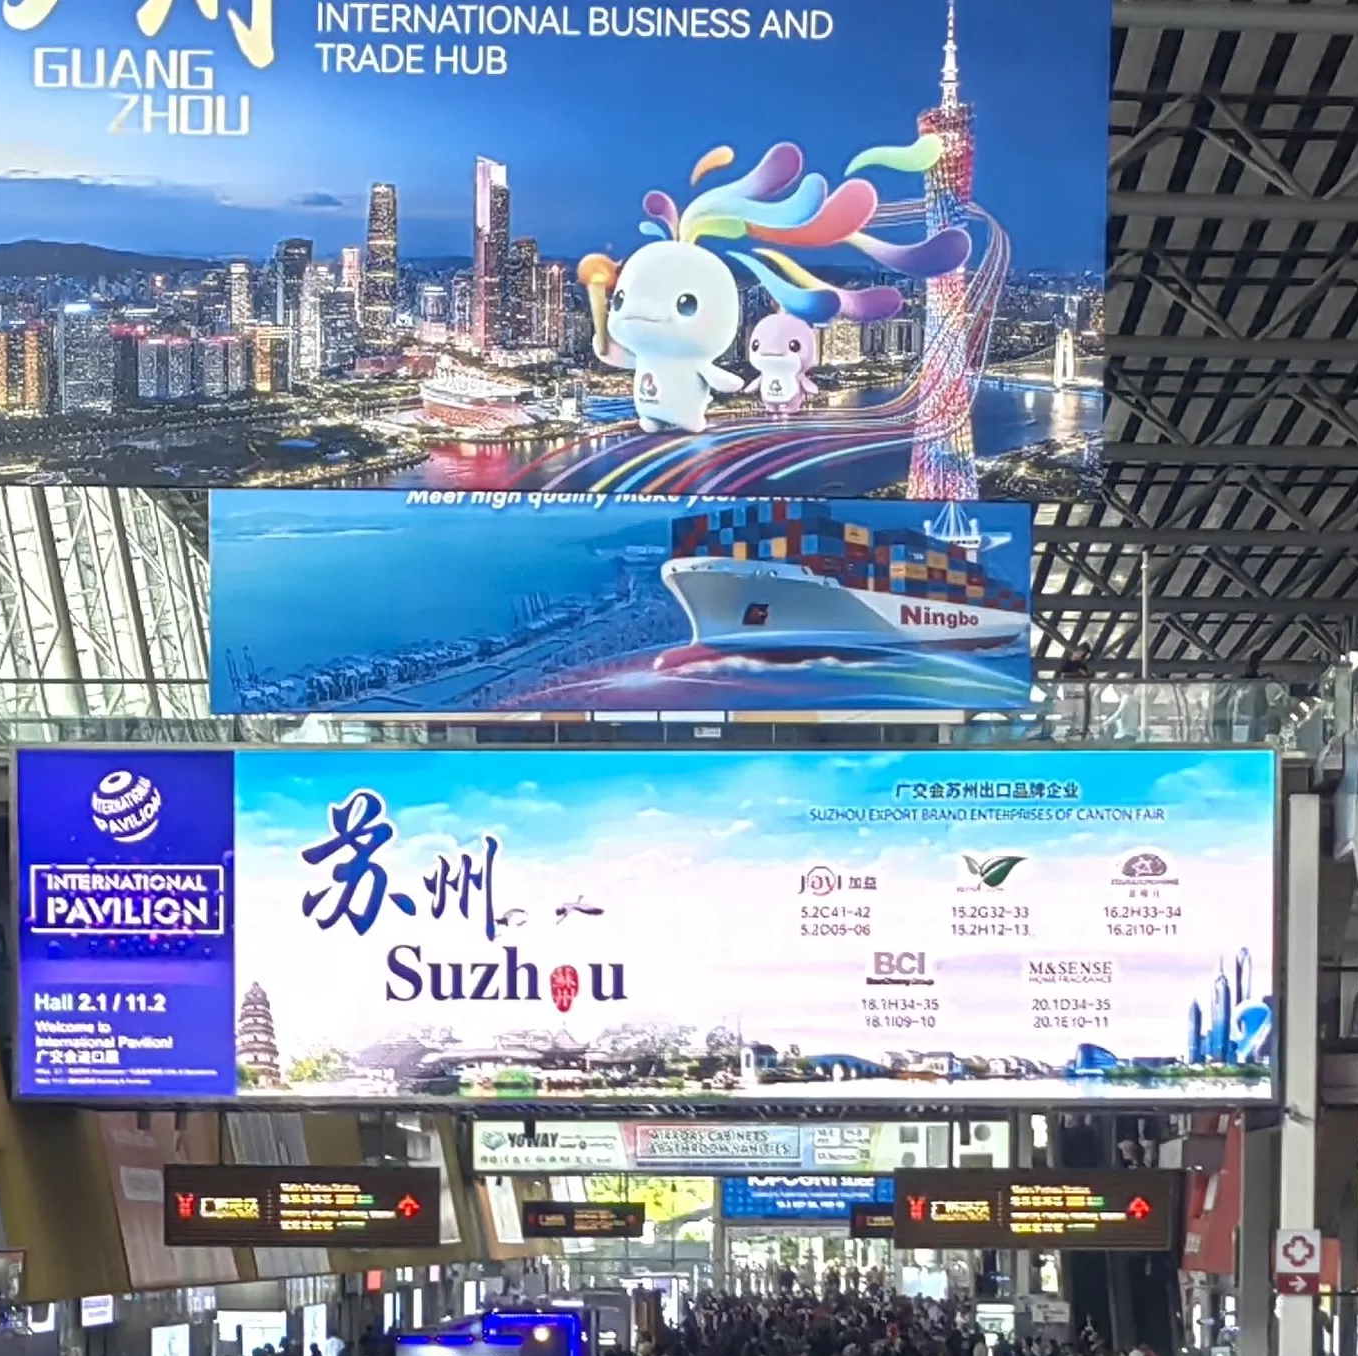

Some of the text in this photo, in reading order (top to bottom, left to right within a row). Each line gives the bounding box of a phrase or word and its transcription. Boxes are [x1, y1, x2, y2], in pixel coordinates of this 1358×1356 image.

[317, 1, 833, 40] INTERNATIONAL BUSINESS AND
[33, 48, 215, 90] GUANG
[315, 43, 508, 76] TRADE HUB
[108, 94, 250, 136] ZHOU
[900, 603, 980, 631] Ningbo
[895, 781, 1080, 800] 广交会苏州出口品牌企业
[92, 787, 162, 833] PAVILION
[809, 808, 866, 822] SUZHOU
[921, 808, 967, 822] BRAND
[1055, 808, 1072, 822] OF
[1076, 808, 1132, 822] CANTON
[1135, 808, 1165, 822] FAIR
[300, 787, 500, 941] 苏州
[46, 873, 208, 892] INTERNATIONAL
[46, 897, 208, 925] PAVILION
[873, 951, 926, 975] BCI
[1028, 960, 1113, 975] M&SENSE
[34, 993, 73, 1012] Hall
[77, 993, 107, 1012] 2.1
[125, 993, 167, 1012] 11.2
